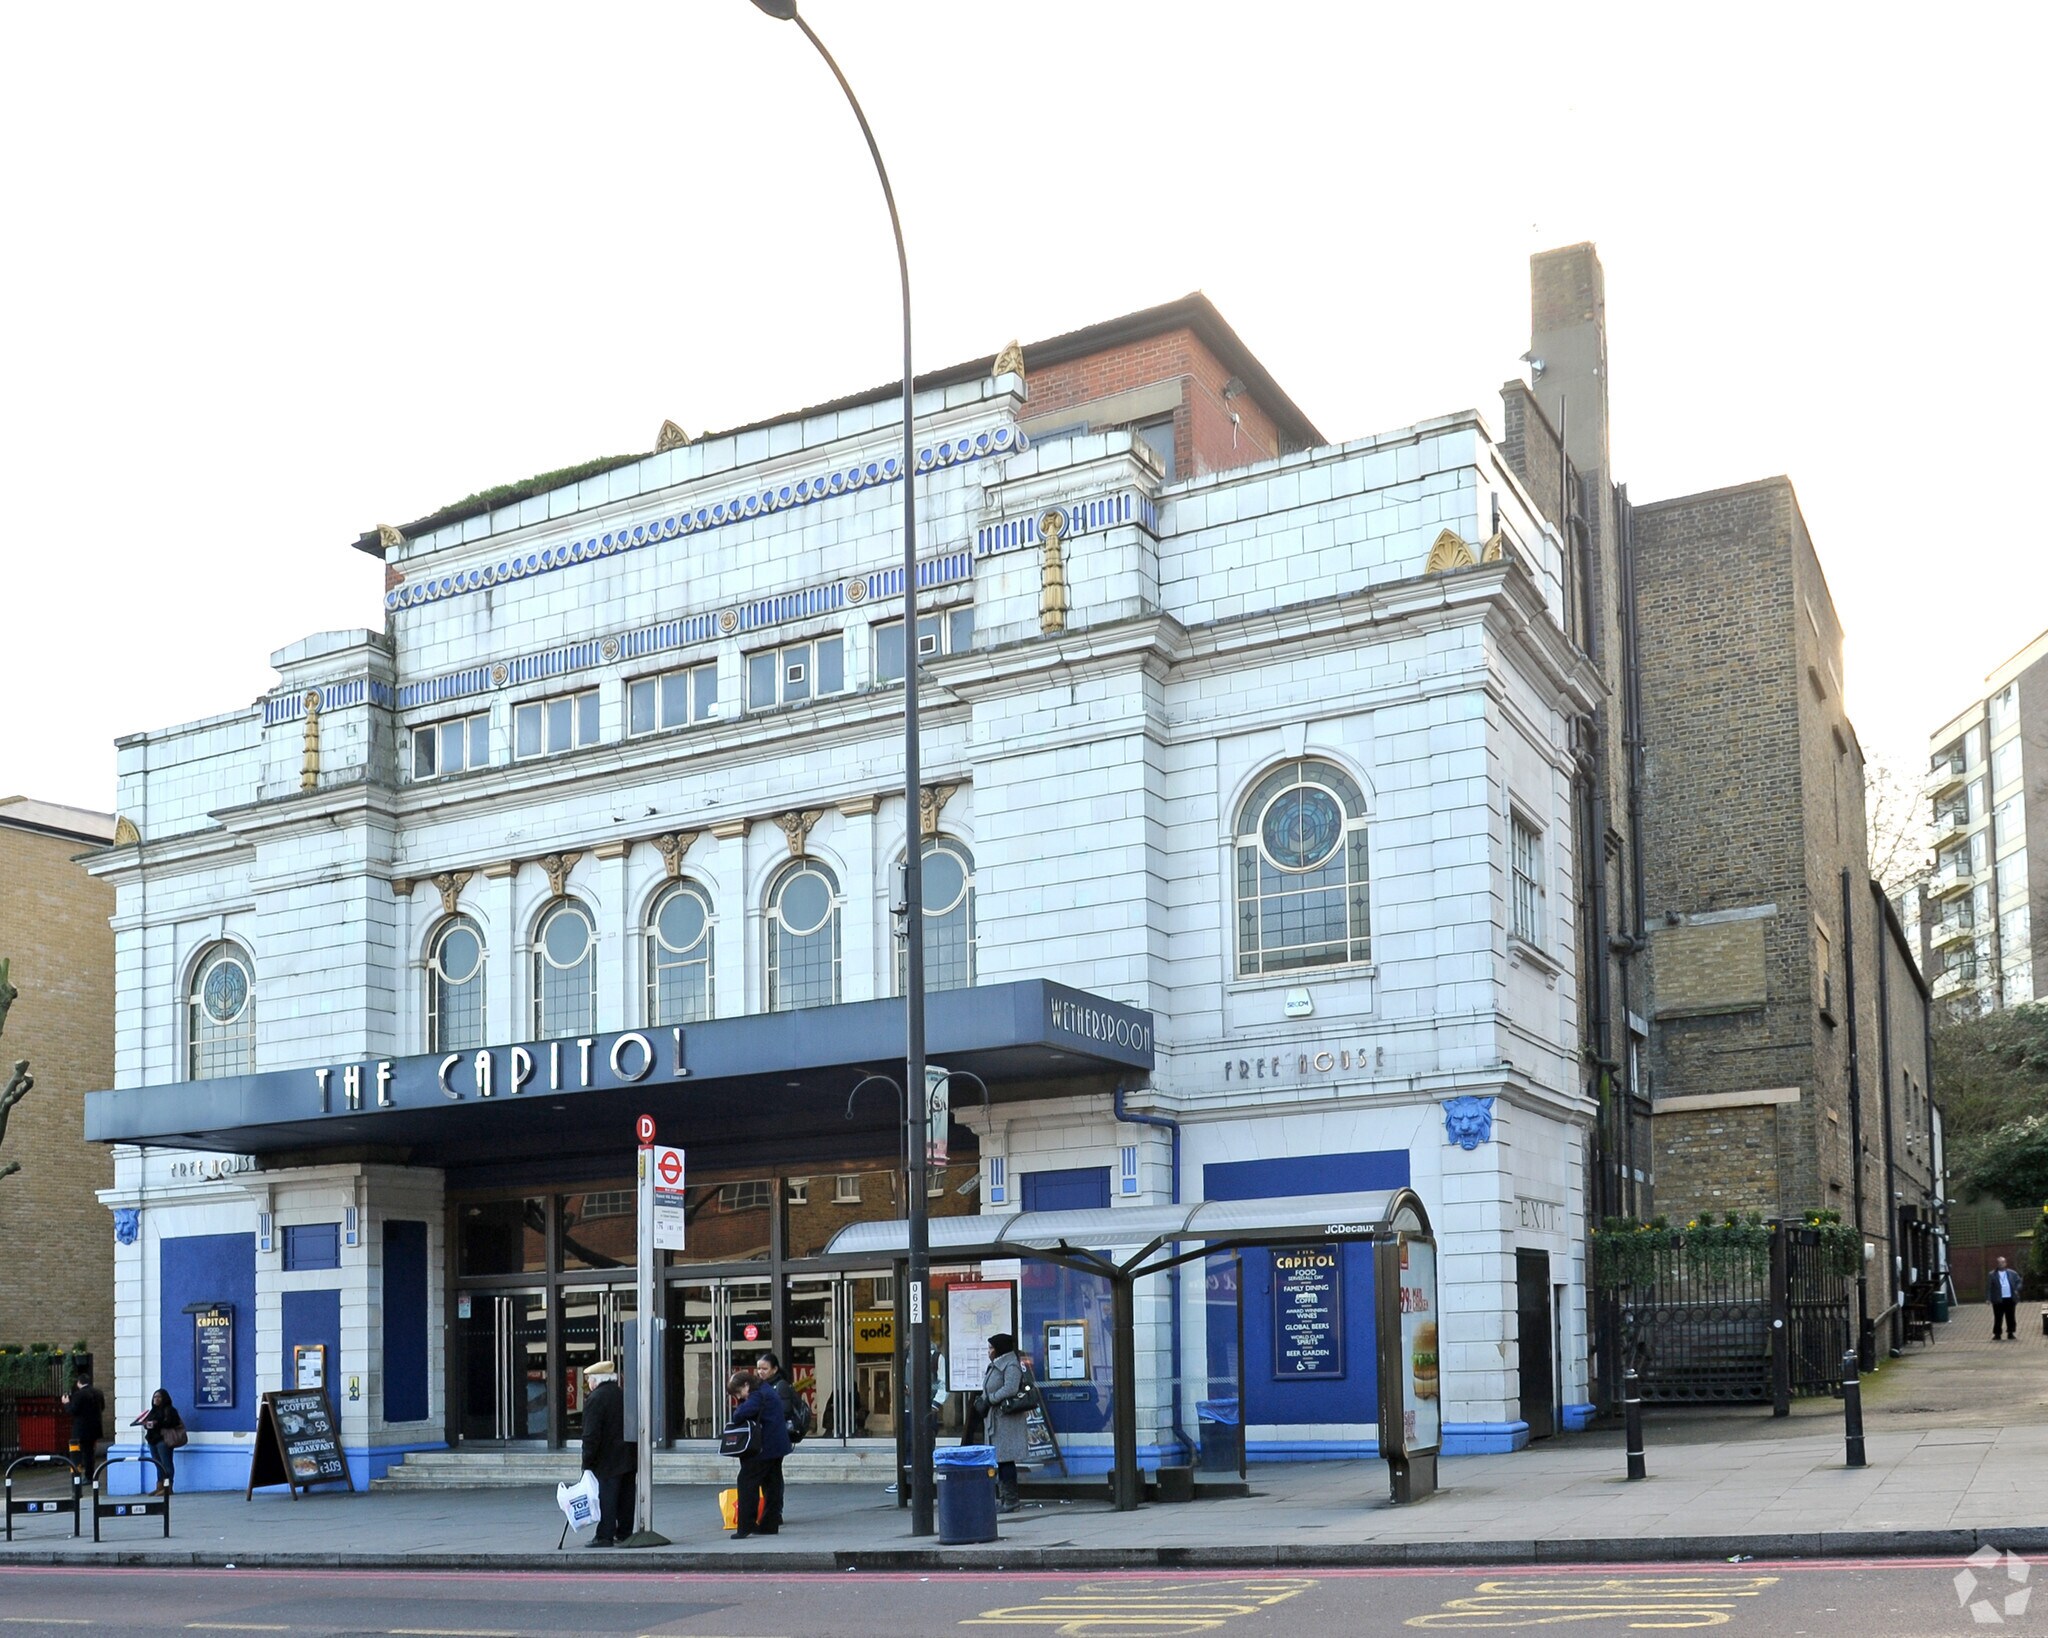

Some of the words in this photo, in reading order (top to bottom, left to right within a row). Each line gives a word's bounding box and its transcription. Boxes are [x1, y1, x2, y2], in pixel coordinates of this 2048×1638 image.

[1050, 997, 1151, 1054] WETHERSPOON
[315, 1061, 395, 1113] THE
[437, 1027, 688, 1099] CAPITOL
[1224, 1056, 1280, 1081] FREE
[1298, 1046, 1384, 1074] HOUSE
[642, 1118, 653, 1138] D
[170, 1160, 203, 1177] FREE
[1520, 1200, 1556, 1230] EXIT
[1324, 1224, 1375, 1235] JCDecaux
[1276, 1255, 1335, 1269] CAPITOL
[197, 1317, 230, 1327] CAPITOL
[1285, 1323, 1310, 1331] GLOBAL
[283, 1401, 318, 1412] COFFEE
[288, 1442, 335, 1455] BREAKFAST
[572, 1500, 589, 1511] TOP
[958, 1578, 1322, 1636] STOP
[1405, 1577, 1781, 1629] BUS
